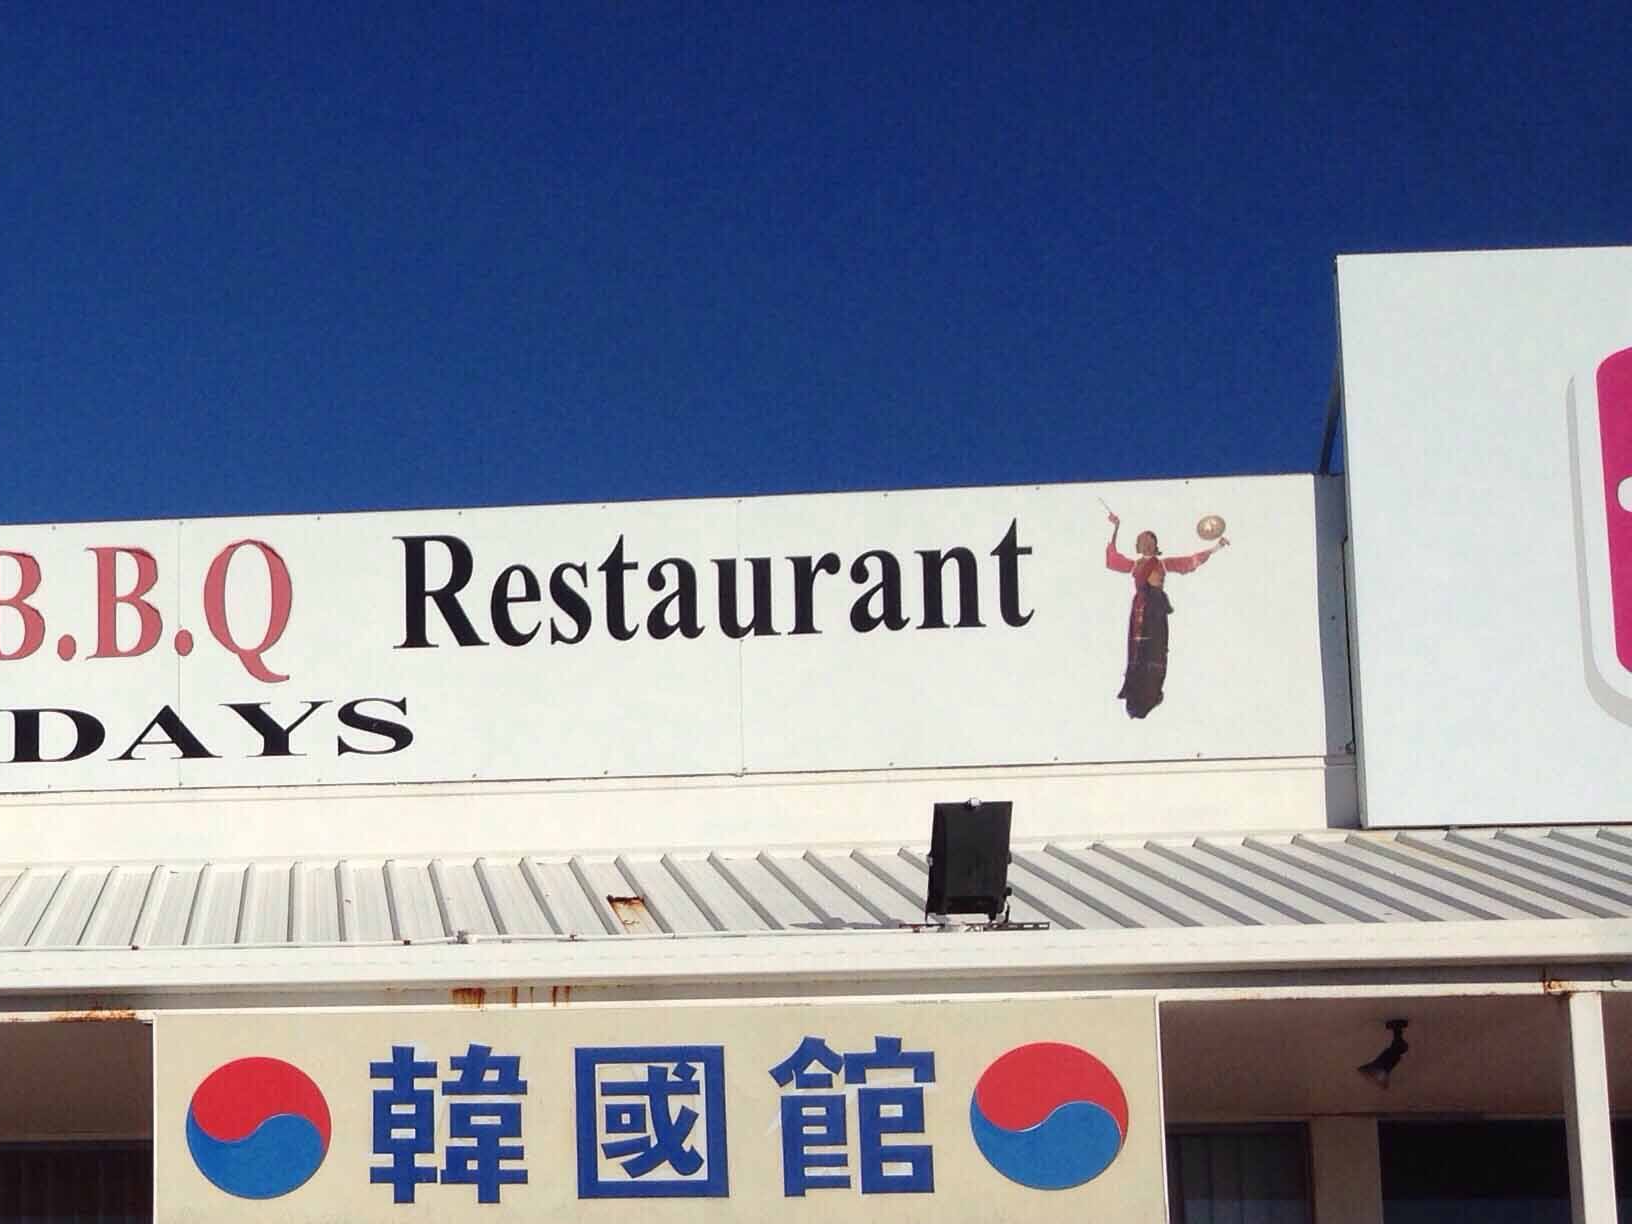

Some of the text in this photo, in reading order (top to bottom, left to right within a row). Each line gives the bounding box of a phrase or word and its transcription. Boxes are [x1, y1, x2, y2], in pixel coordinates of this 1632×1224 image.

[394, 519, 1034, 648] Restaurant
[10, 697, 414, 763] DAYS
[370, 1037, 935, 1204] 韓國館
